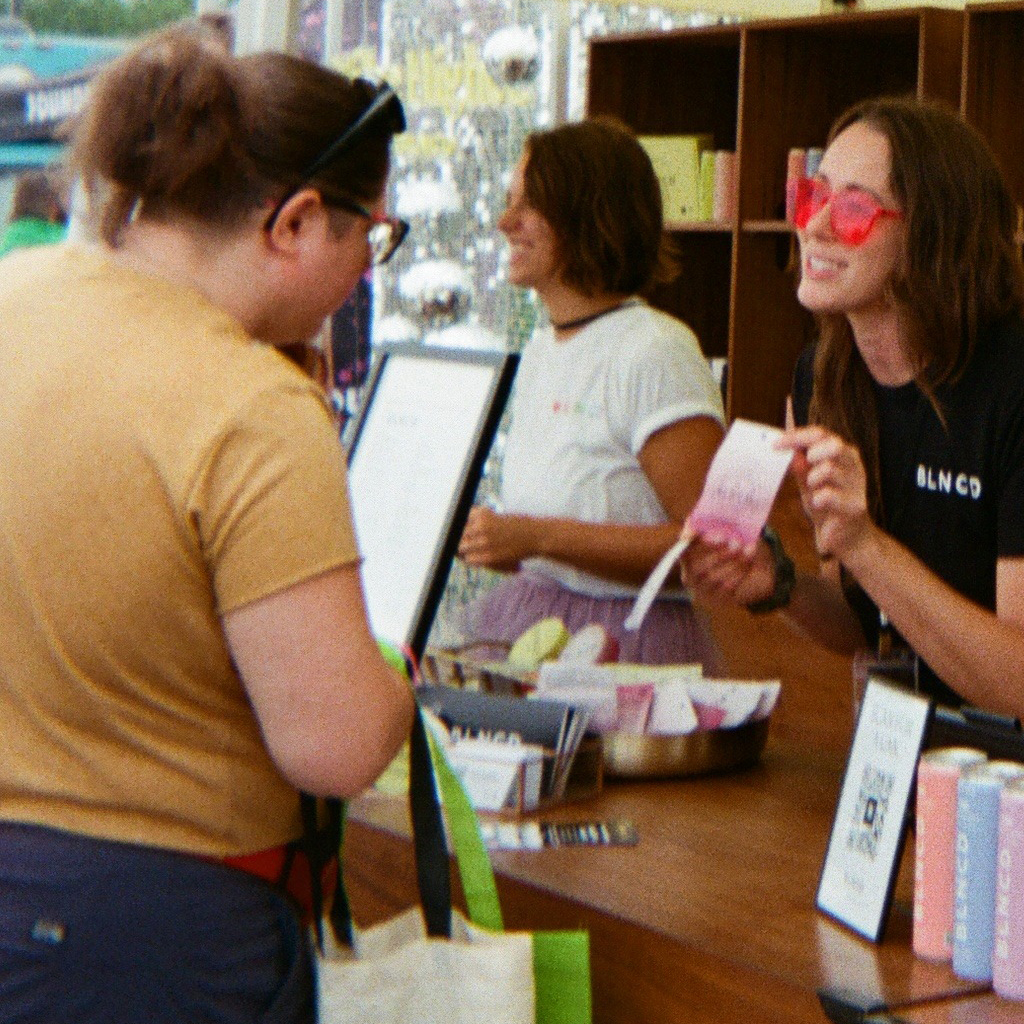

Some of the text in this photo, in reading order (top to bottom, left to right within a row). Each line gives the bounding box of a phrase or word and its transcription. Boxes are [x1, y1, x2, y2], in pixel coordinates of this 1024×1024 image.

[917, 463, 981, 500] BLNCD
[955, 830, 968, 941] BLNCD
[996, 849, 1012, 959] BLNCD
